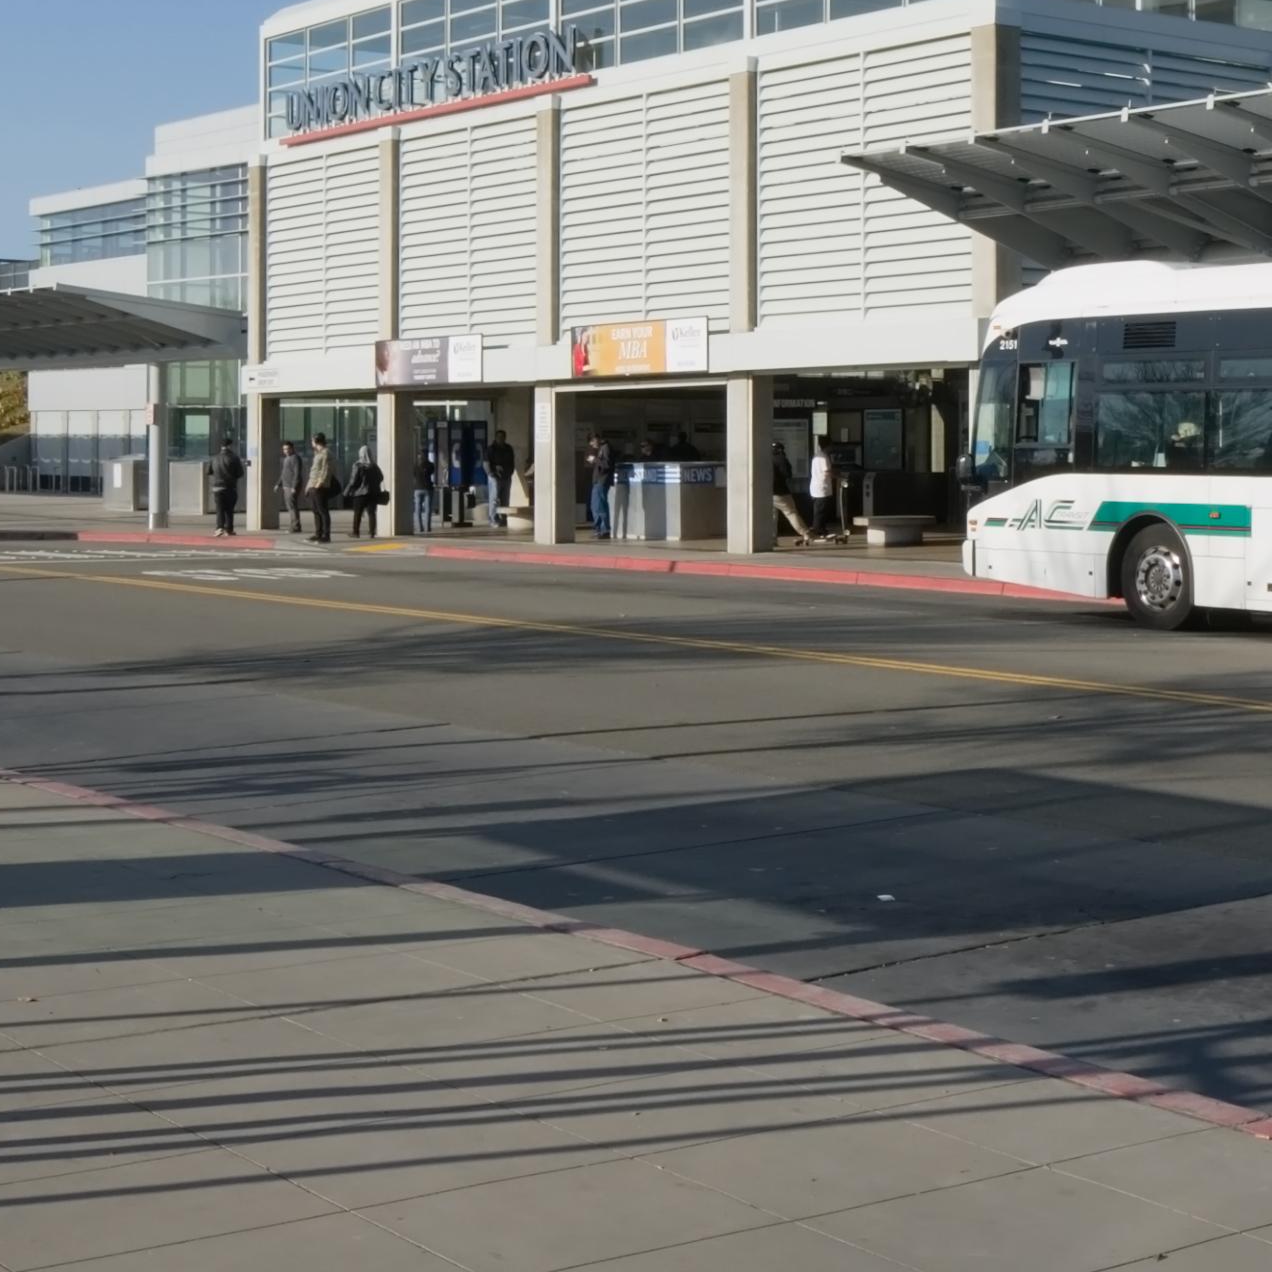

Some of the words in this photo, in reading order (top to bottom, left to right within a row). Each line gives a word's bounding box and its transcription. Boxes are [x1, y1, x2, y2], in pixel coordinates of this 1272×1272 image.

[285, 73, 370, 131] UNION
[373, 56, 440, 112] CITY
[445, 24, 577, 97] STATION
[618, 340, 648, 360] MBA
[999, 339, 1018, 350] 2151
[772, 399, 815, 408] NFORMATION
[684, 468, 713, 483] NEWS
